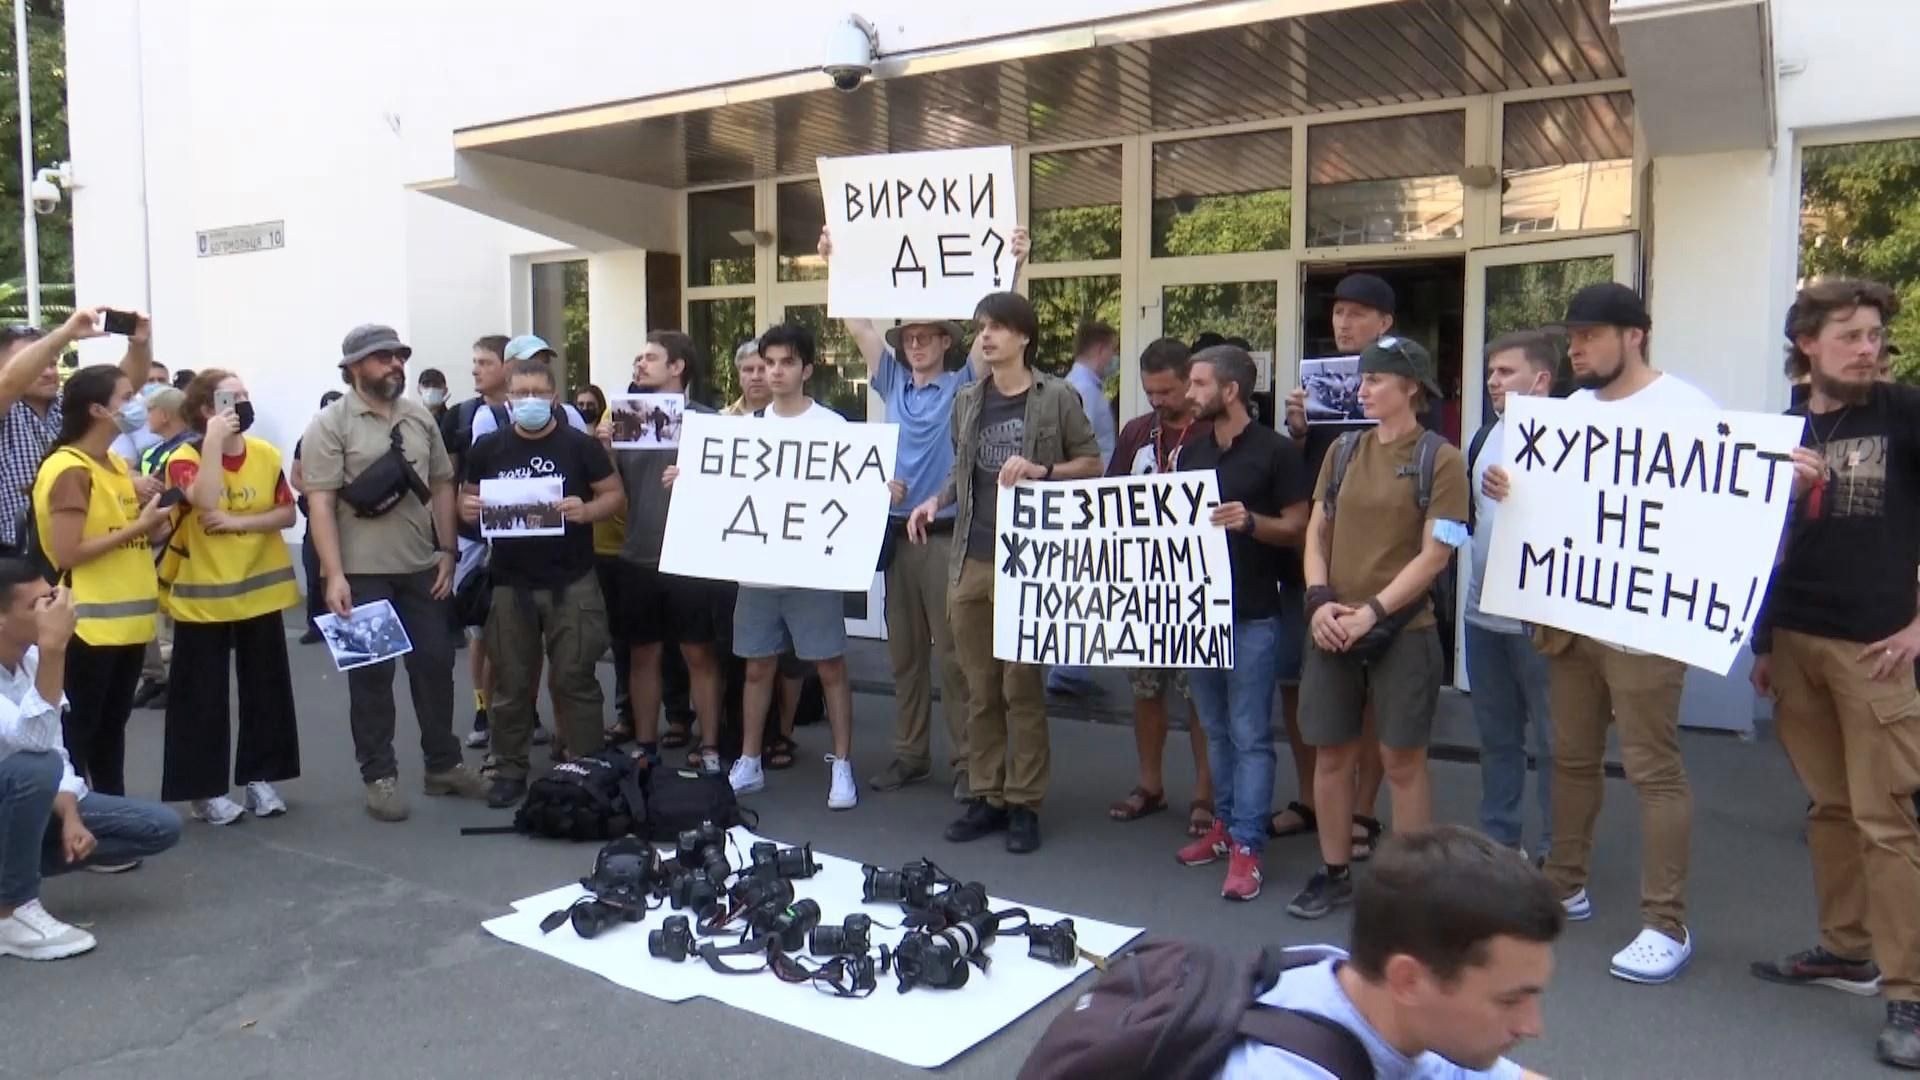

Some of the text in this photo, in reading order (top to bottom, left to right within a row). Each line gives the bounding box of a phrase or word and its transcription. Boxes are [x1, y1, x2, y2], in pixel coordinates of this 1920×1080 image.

[845, 173, 994, 222] ВИРОКИ
[269, 229, 282, 246] 10
[892, 228, 1005, 288] ДЕ?
[700, 437, 887, 484] БЕЗПЕКА
[722, 495, 848, 555] ДЕ?
[1597, 489, 1664, 554] НЕ
[1017, 619, 1232, 667] НАПАДНИКАМ
